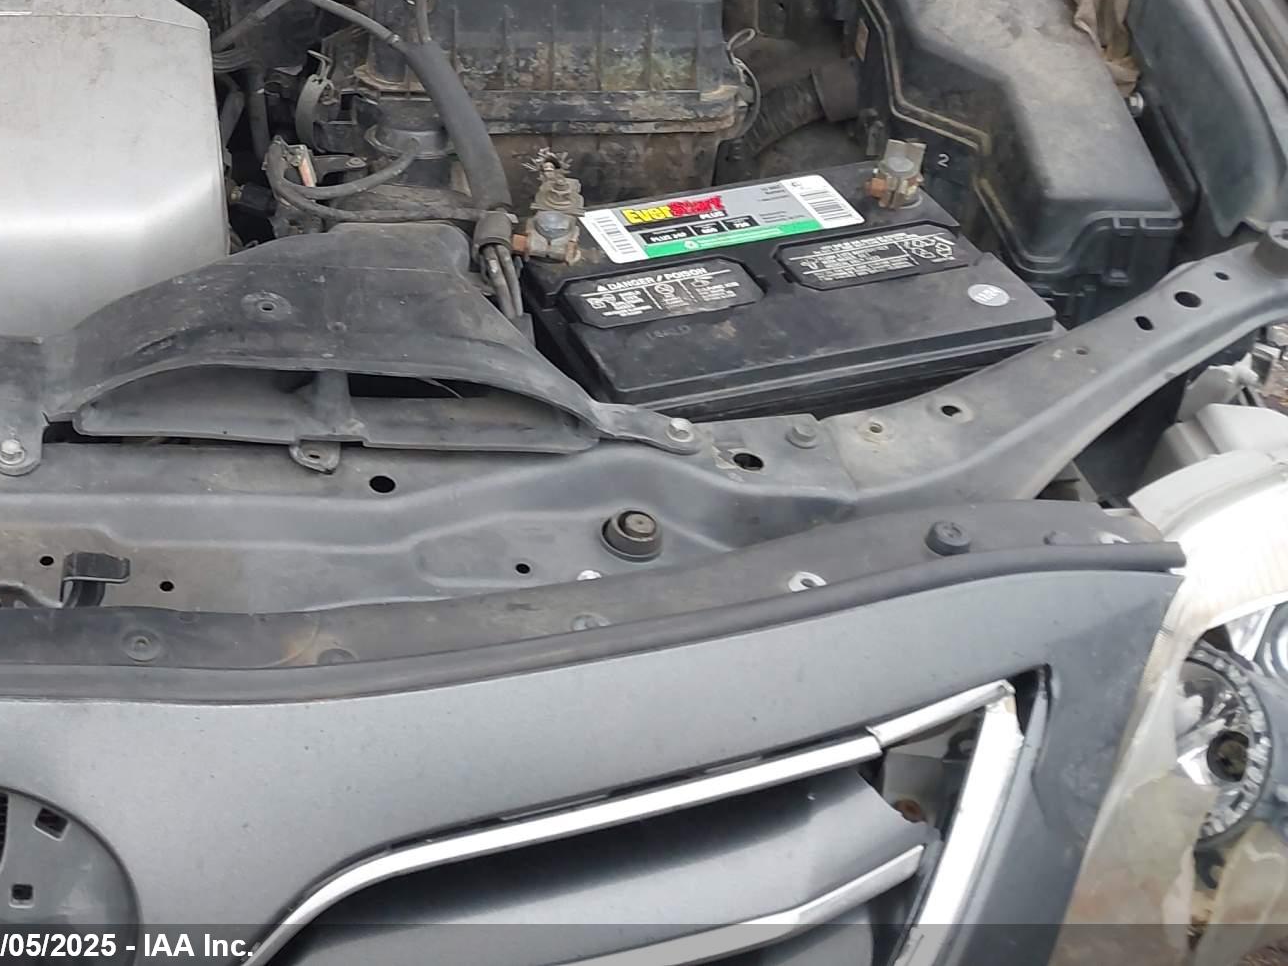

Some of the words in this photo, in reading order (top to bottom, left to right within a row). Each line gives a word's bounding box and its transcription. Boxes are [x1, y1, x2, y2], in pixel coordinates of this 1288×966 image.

[937, 153, 950, 168] 2
[623, 197, 723, 224] EverStart
[699, 210, 726, 220] PLUS
[607, 277, 655, 290] DANGER
[663, 267, 708, 281] POISON
